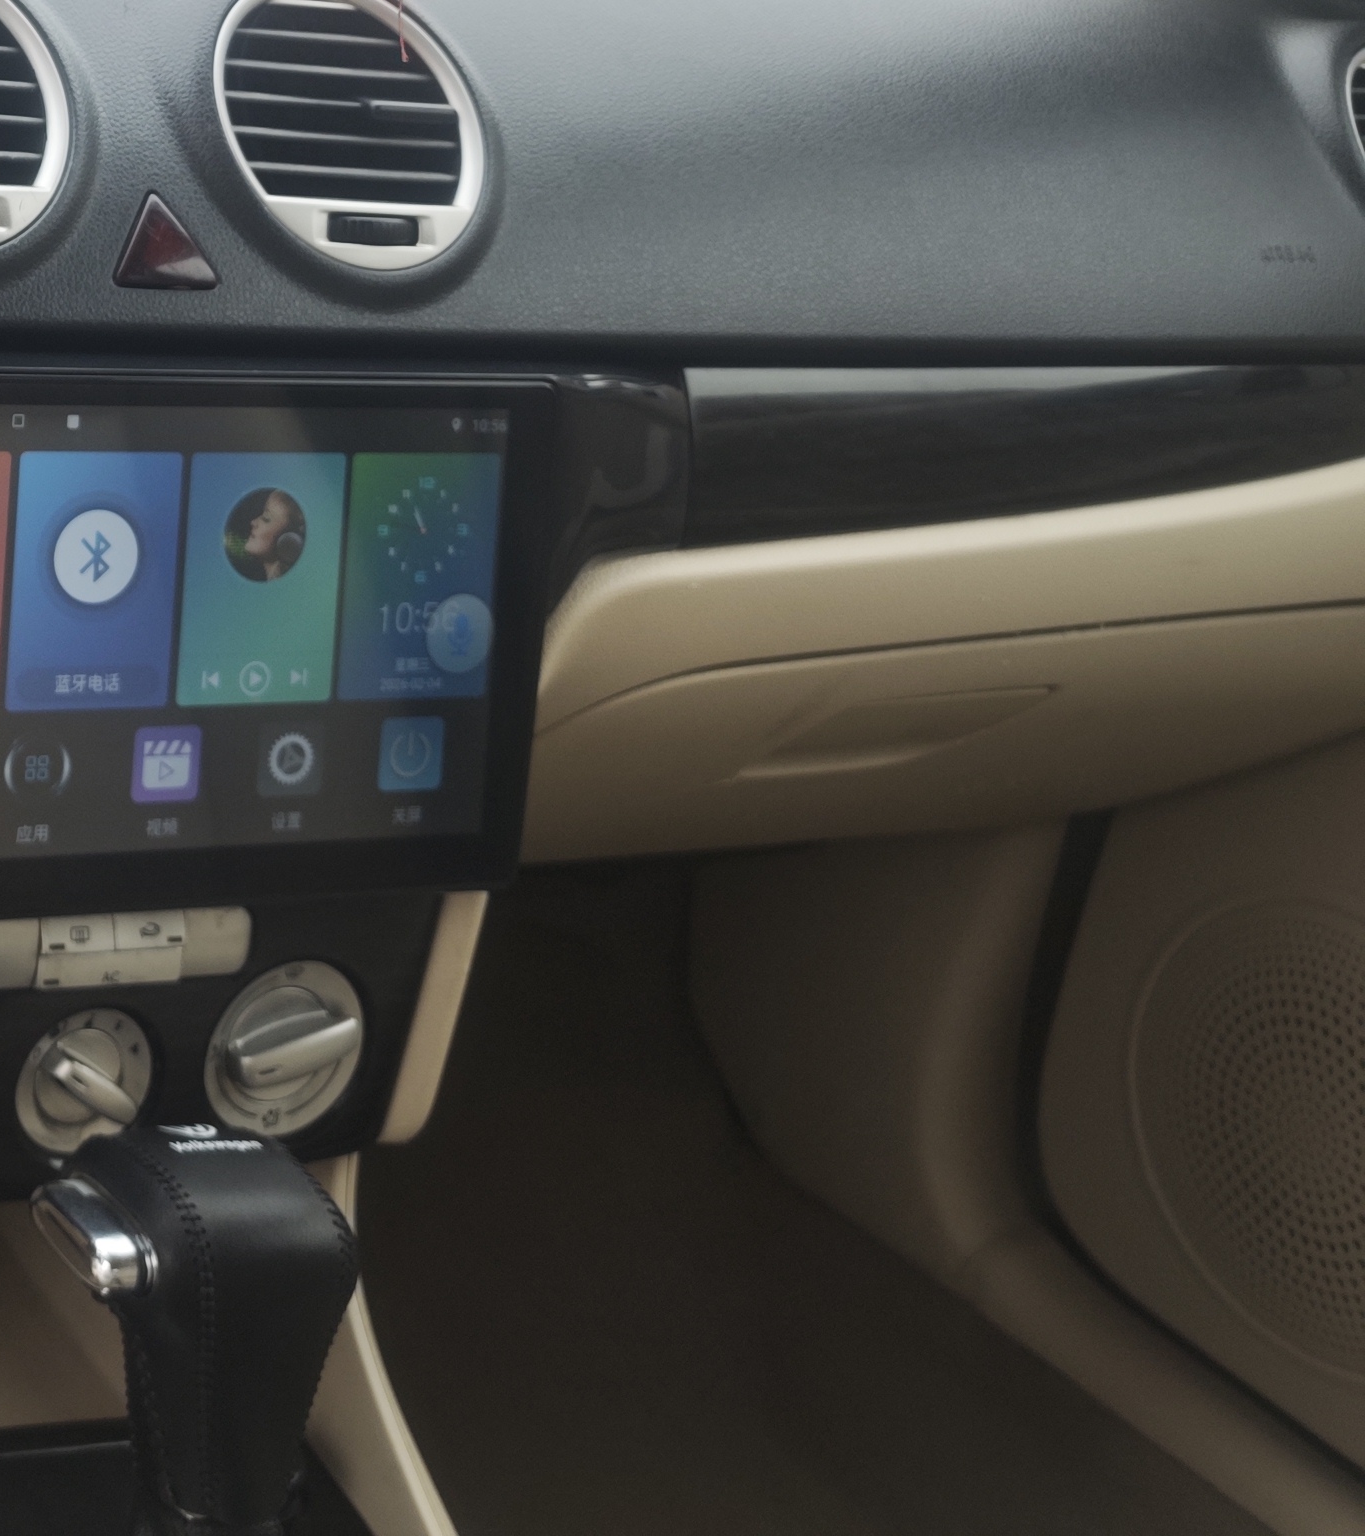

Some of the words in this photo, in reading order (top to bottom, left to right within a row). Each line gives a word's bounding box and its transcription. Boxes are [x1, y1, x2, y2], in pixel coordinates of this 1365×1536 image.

[55, 673, 120, 694] 蓝牙电话
[16, 824, 50, 843] 应用
